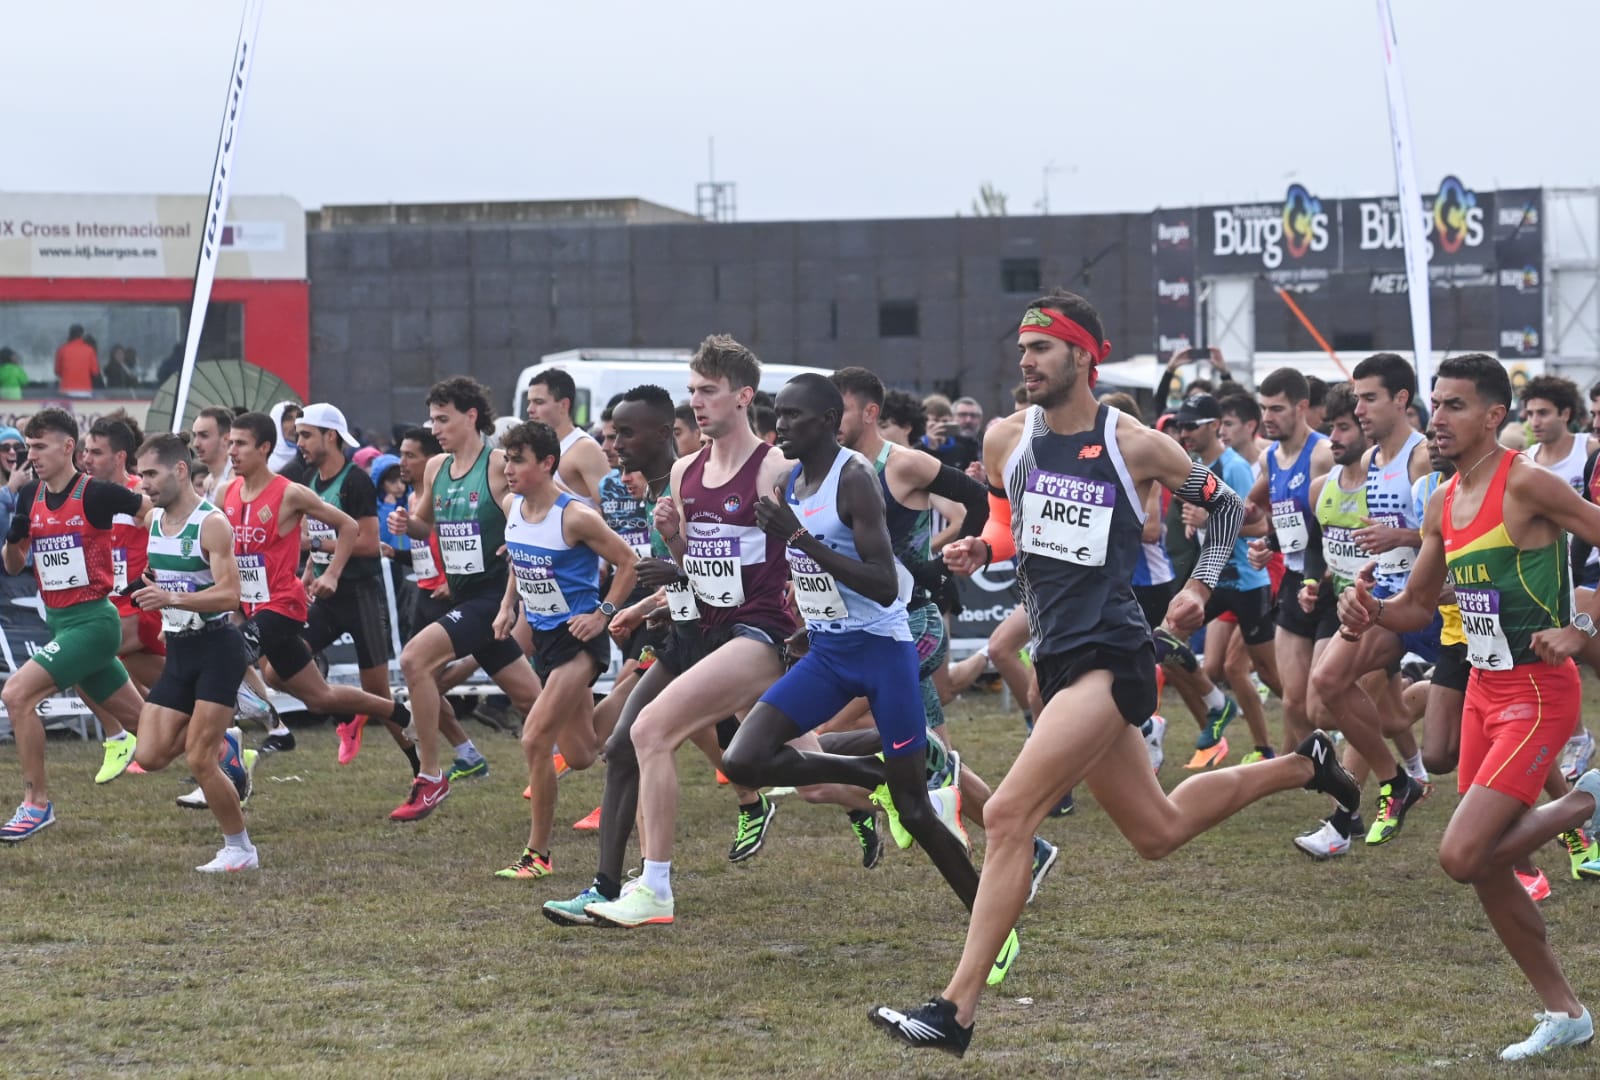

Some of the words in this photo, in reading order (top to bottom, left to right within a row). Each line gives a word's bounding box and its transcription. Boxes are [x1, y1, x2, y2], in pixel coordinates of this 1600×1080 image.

[20, 221, 70, 237] Cross
[76, 221, 191, 238] Internacional
[1212, 184, 1329, 269] Burgos
[1360, 176, 1484, 266] Bugos
[39, 246, 157, 260] www.idj.burgos.es
[1038, 474, 1105, 495] DIPUTACIÓN
[1035, 482, 1104, 505] BURGOS
[1040, 500, 1092, 528] ARCE
[1031, 525, 1042, 535] 12
[440, 539, 477, 551] MARTINEZ
[687, 547, 732, 557] URGOS
[1032, 538, 1069, 555] iberCaja
[1328, 541, 1370, 559] GOMEZ
[42, 551, 70, 568] ONIS
[686, 560, 734, 577] DALTON
